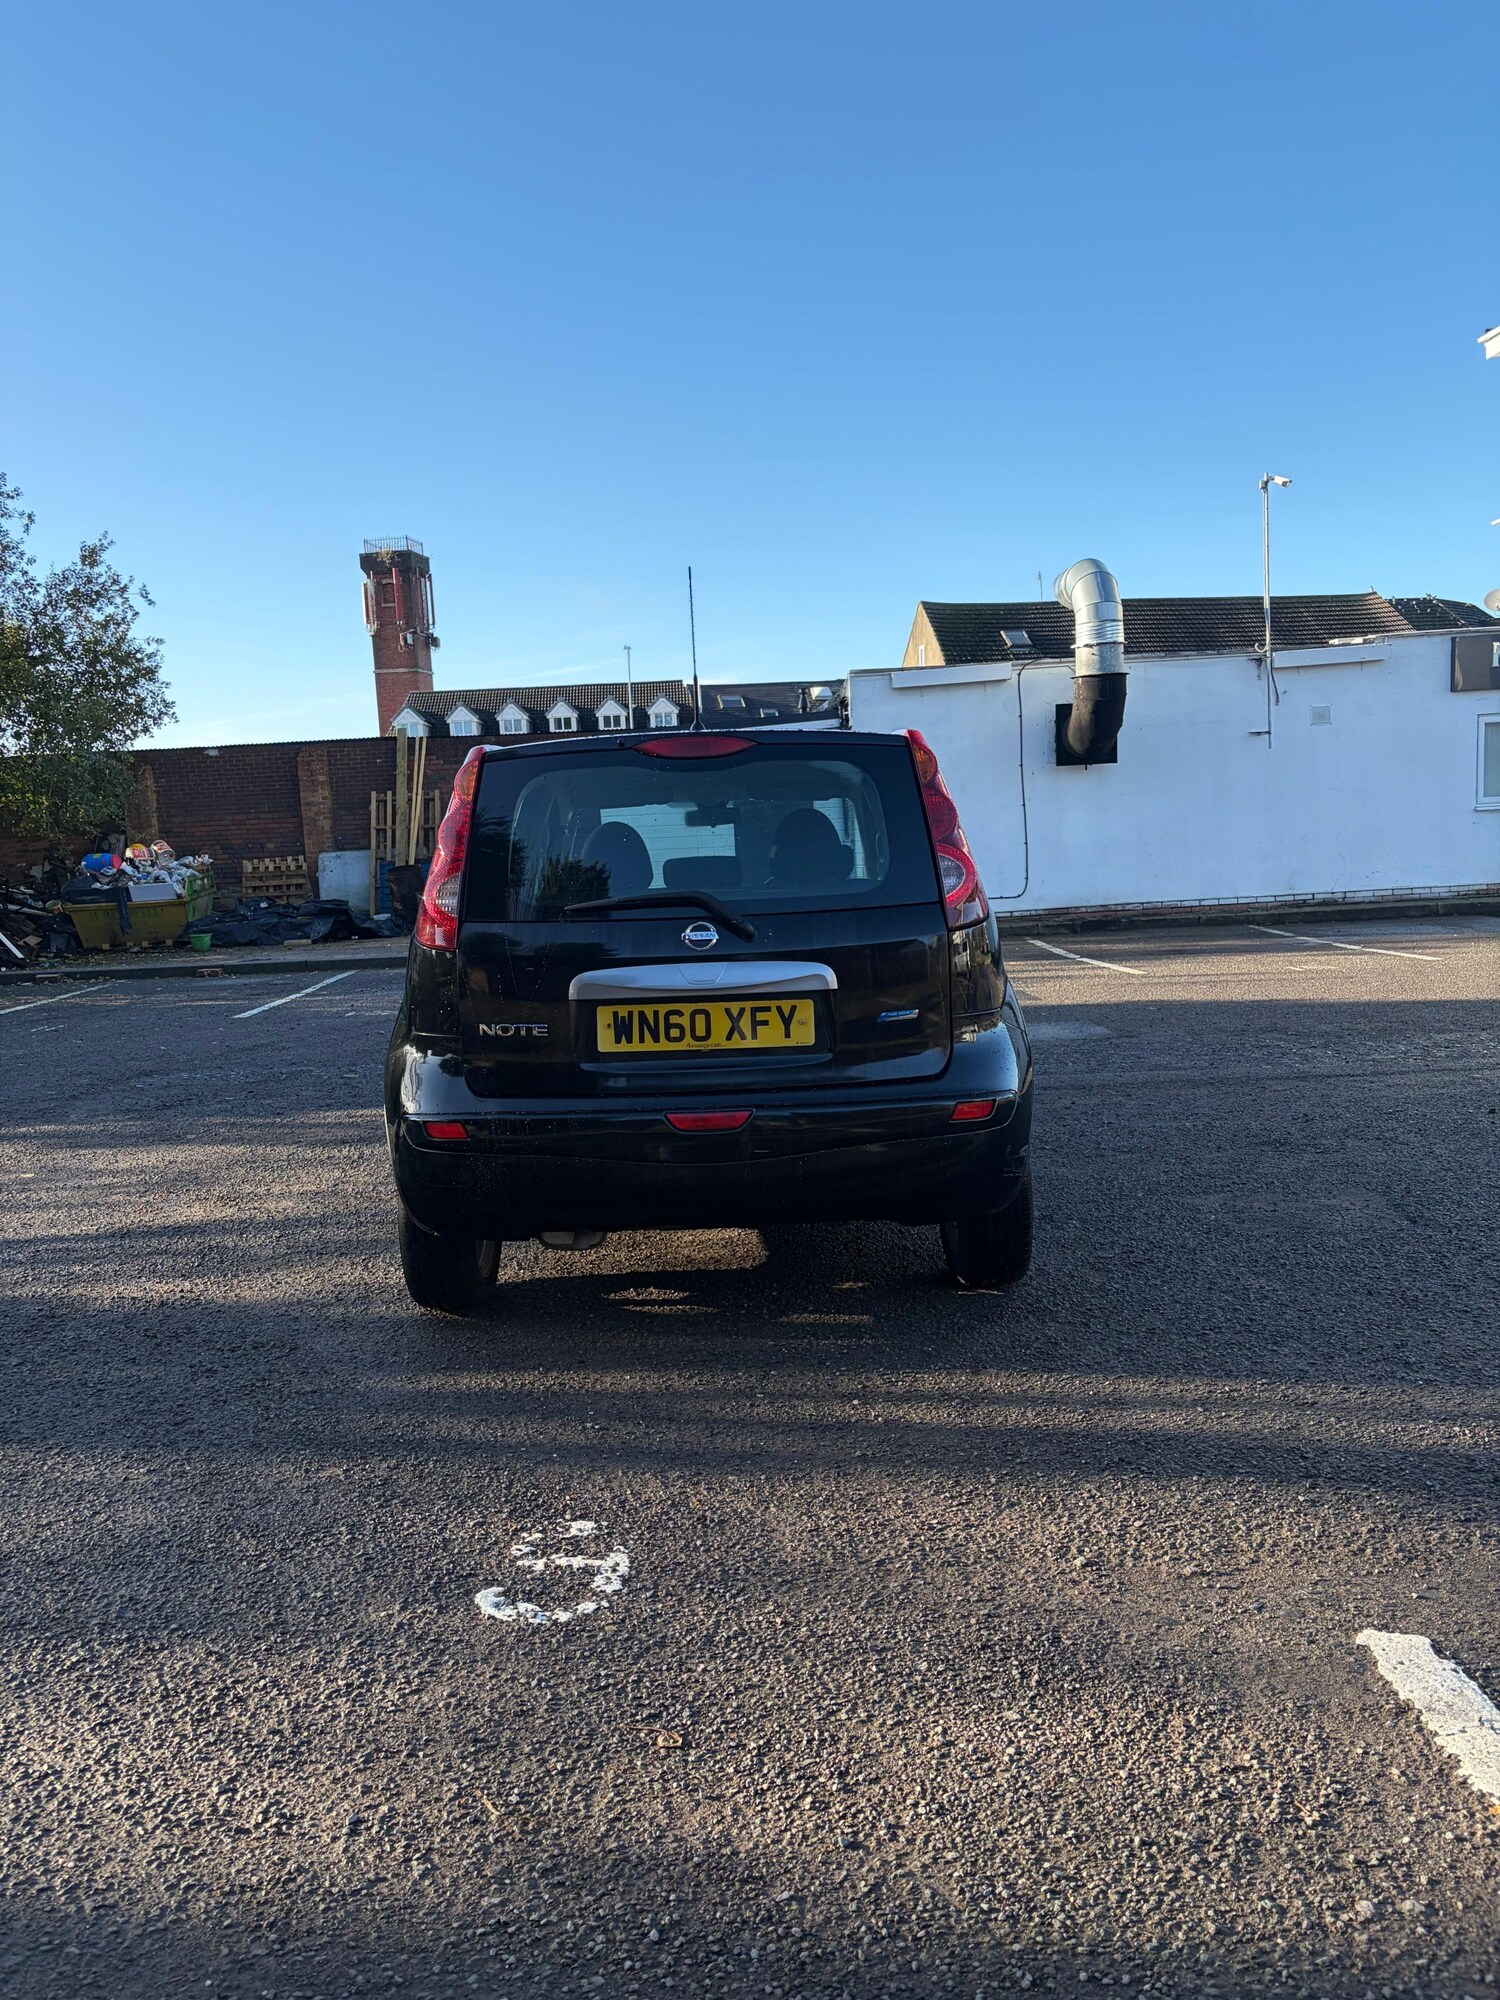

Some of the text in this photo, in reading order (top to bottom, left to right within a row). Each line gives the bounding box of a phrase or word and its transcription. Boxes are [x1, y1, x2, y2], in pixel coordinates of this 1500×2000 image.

[479, 1023, 548, 1036] NOTE
[612, 1005, 797, 1044] WN60 XFY
